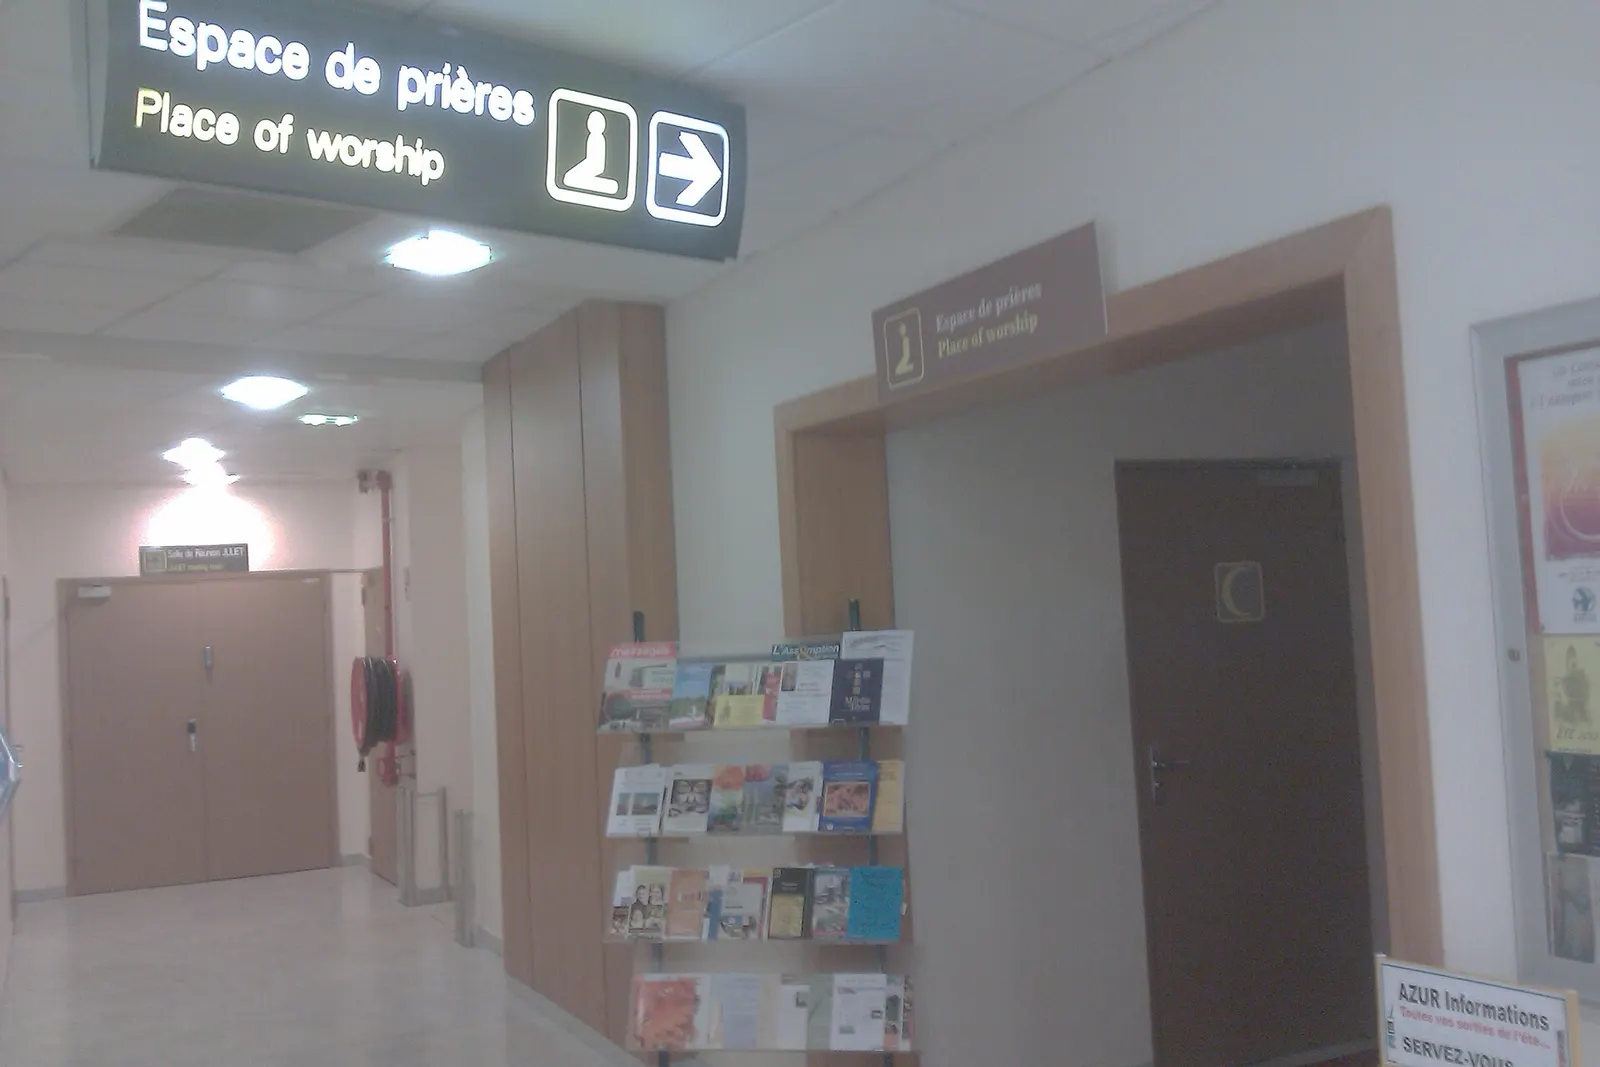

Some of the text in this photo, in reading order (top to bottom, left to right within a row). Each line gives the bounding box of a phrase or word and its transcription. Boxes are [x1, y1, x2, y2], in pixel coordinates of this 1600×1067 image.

[138, 0, 536, 126] Espace de prières
[134, 86, 446, 186] Place of worship
[935, 282, 1042, 333] Espace de prières
[937, 309, 1039, 360] Place of worship
[1399, 983, 1550, 1031] AZUR Informations
